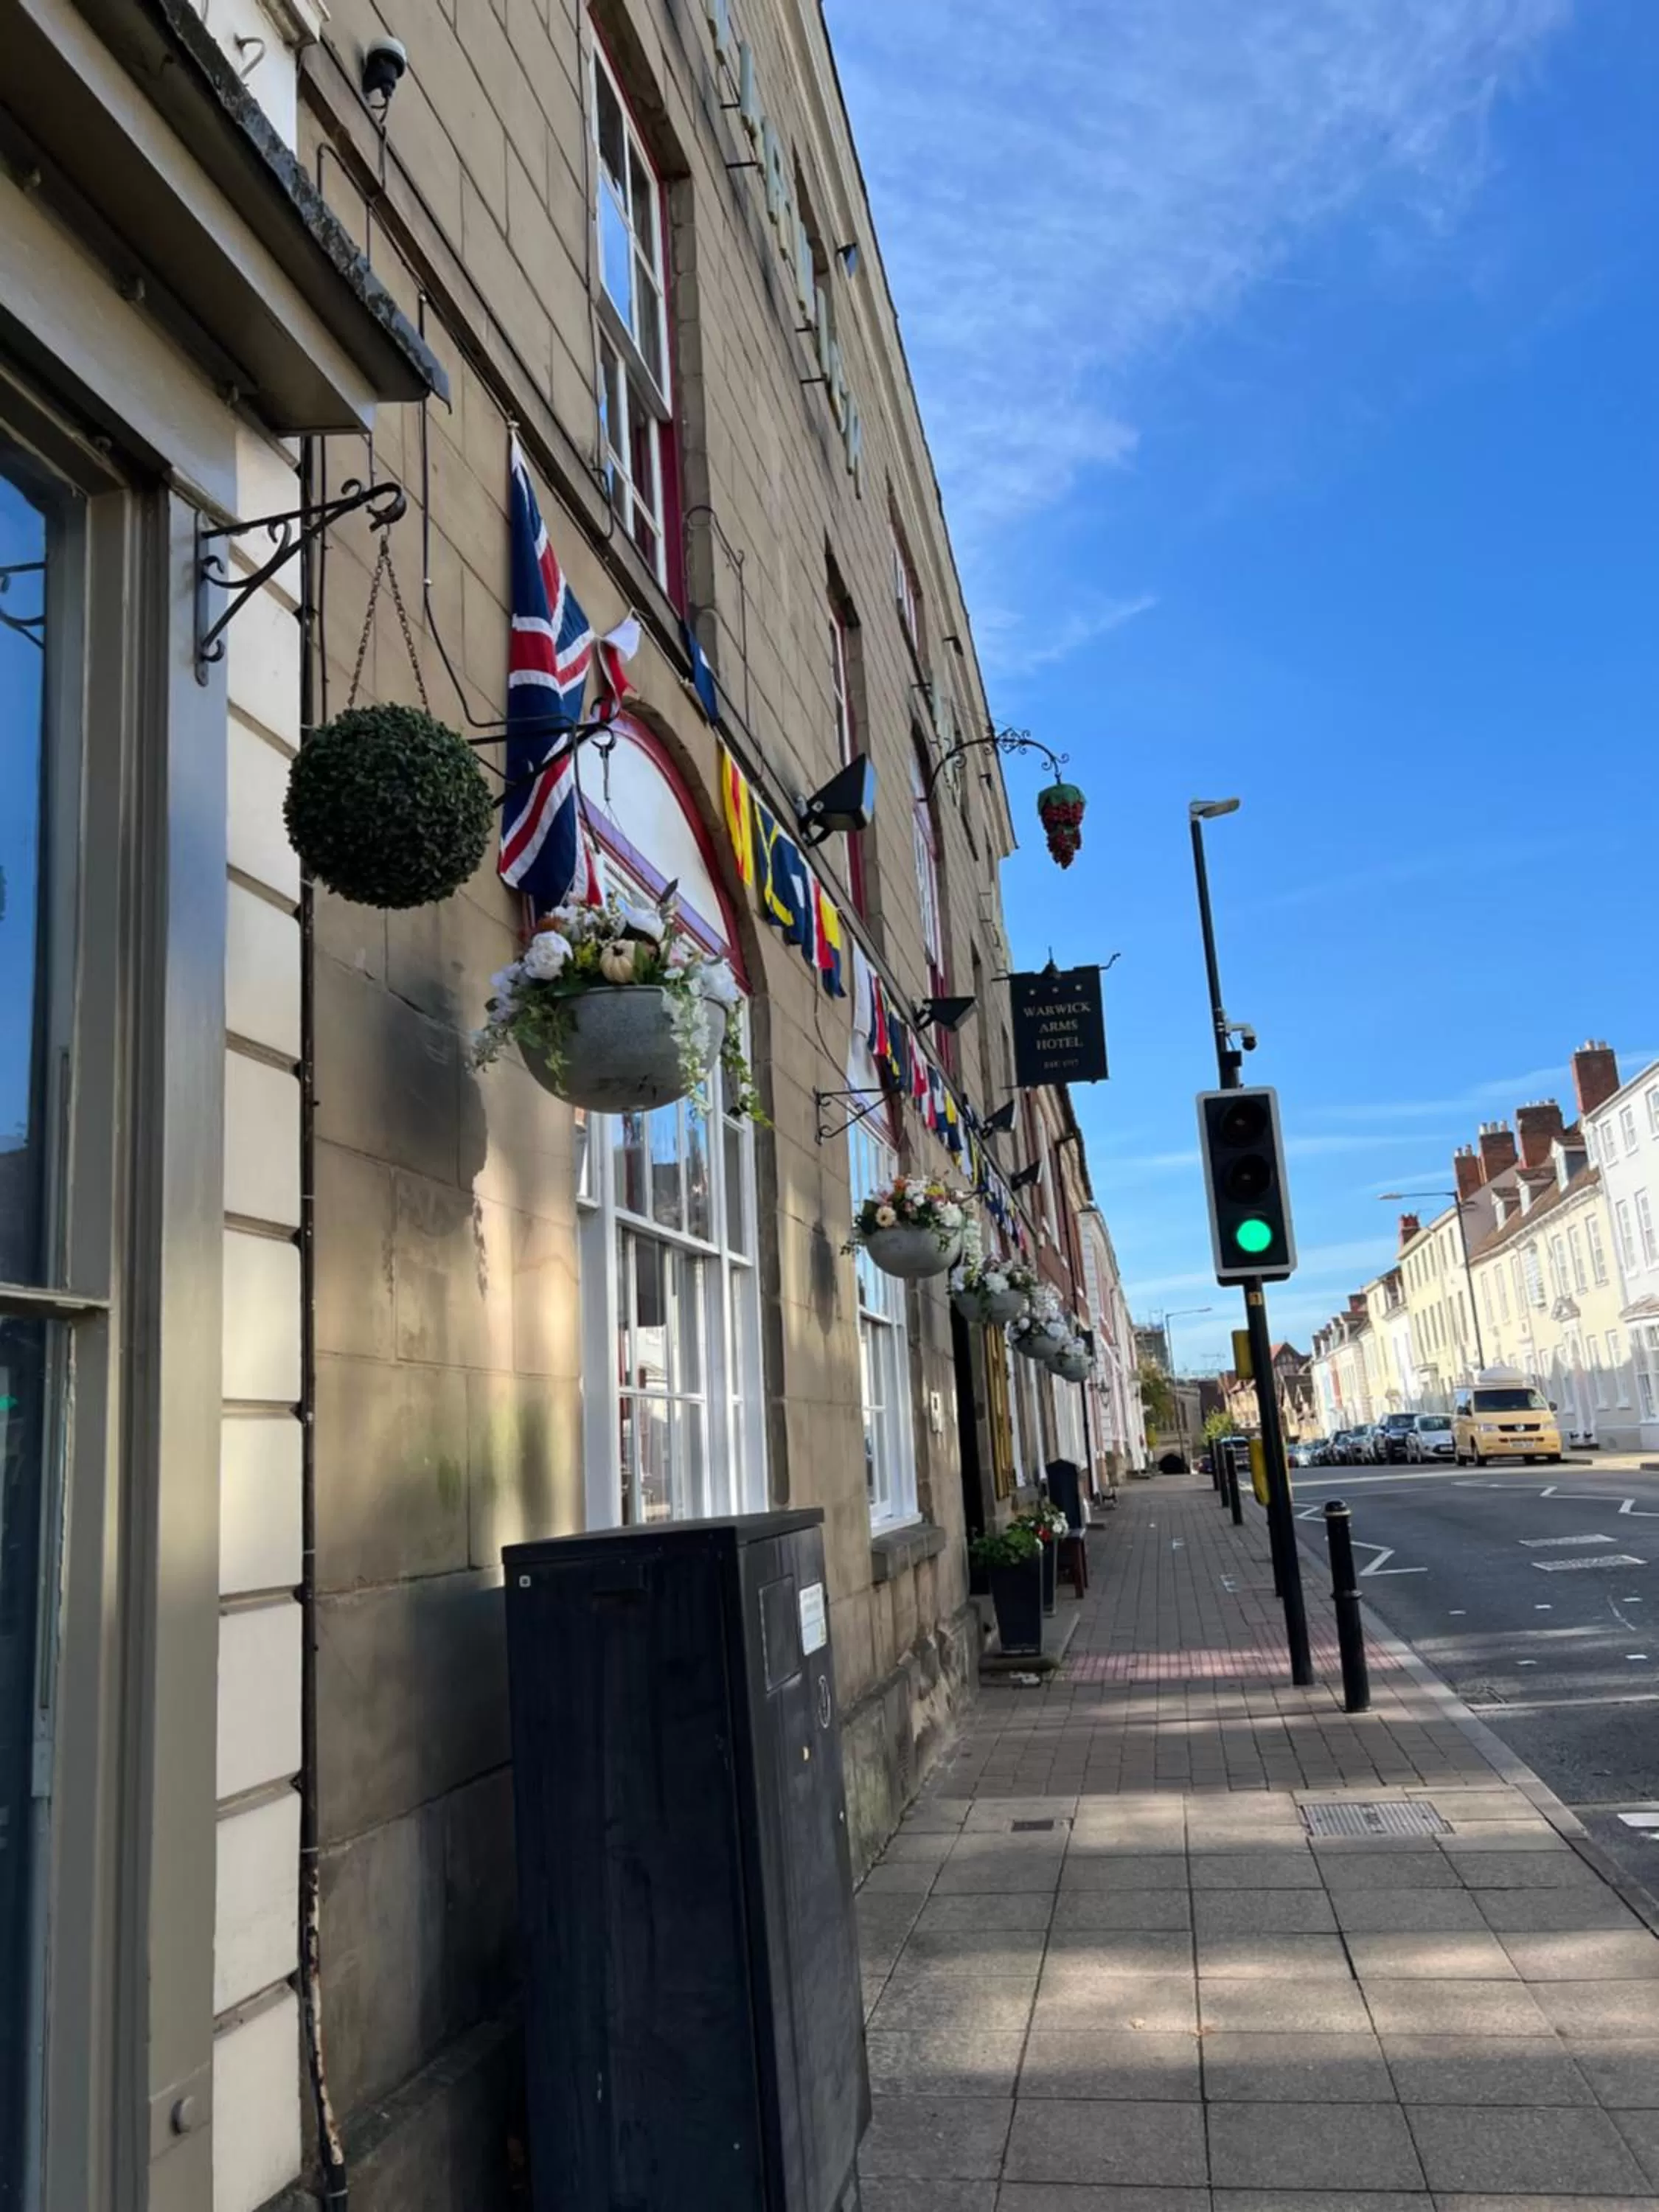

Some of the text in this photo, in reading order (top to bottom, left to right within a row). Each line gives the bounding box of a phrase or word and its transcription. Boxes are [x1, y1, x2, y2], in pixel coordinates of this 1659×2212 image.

[1023, 1002, 1091, 1017] WARWICK
[1039, 1019, 1078, 1033] ARMS
[1036, 1036, 1083, 1050] HOTEL
